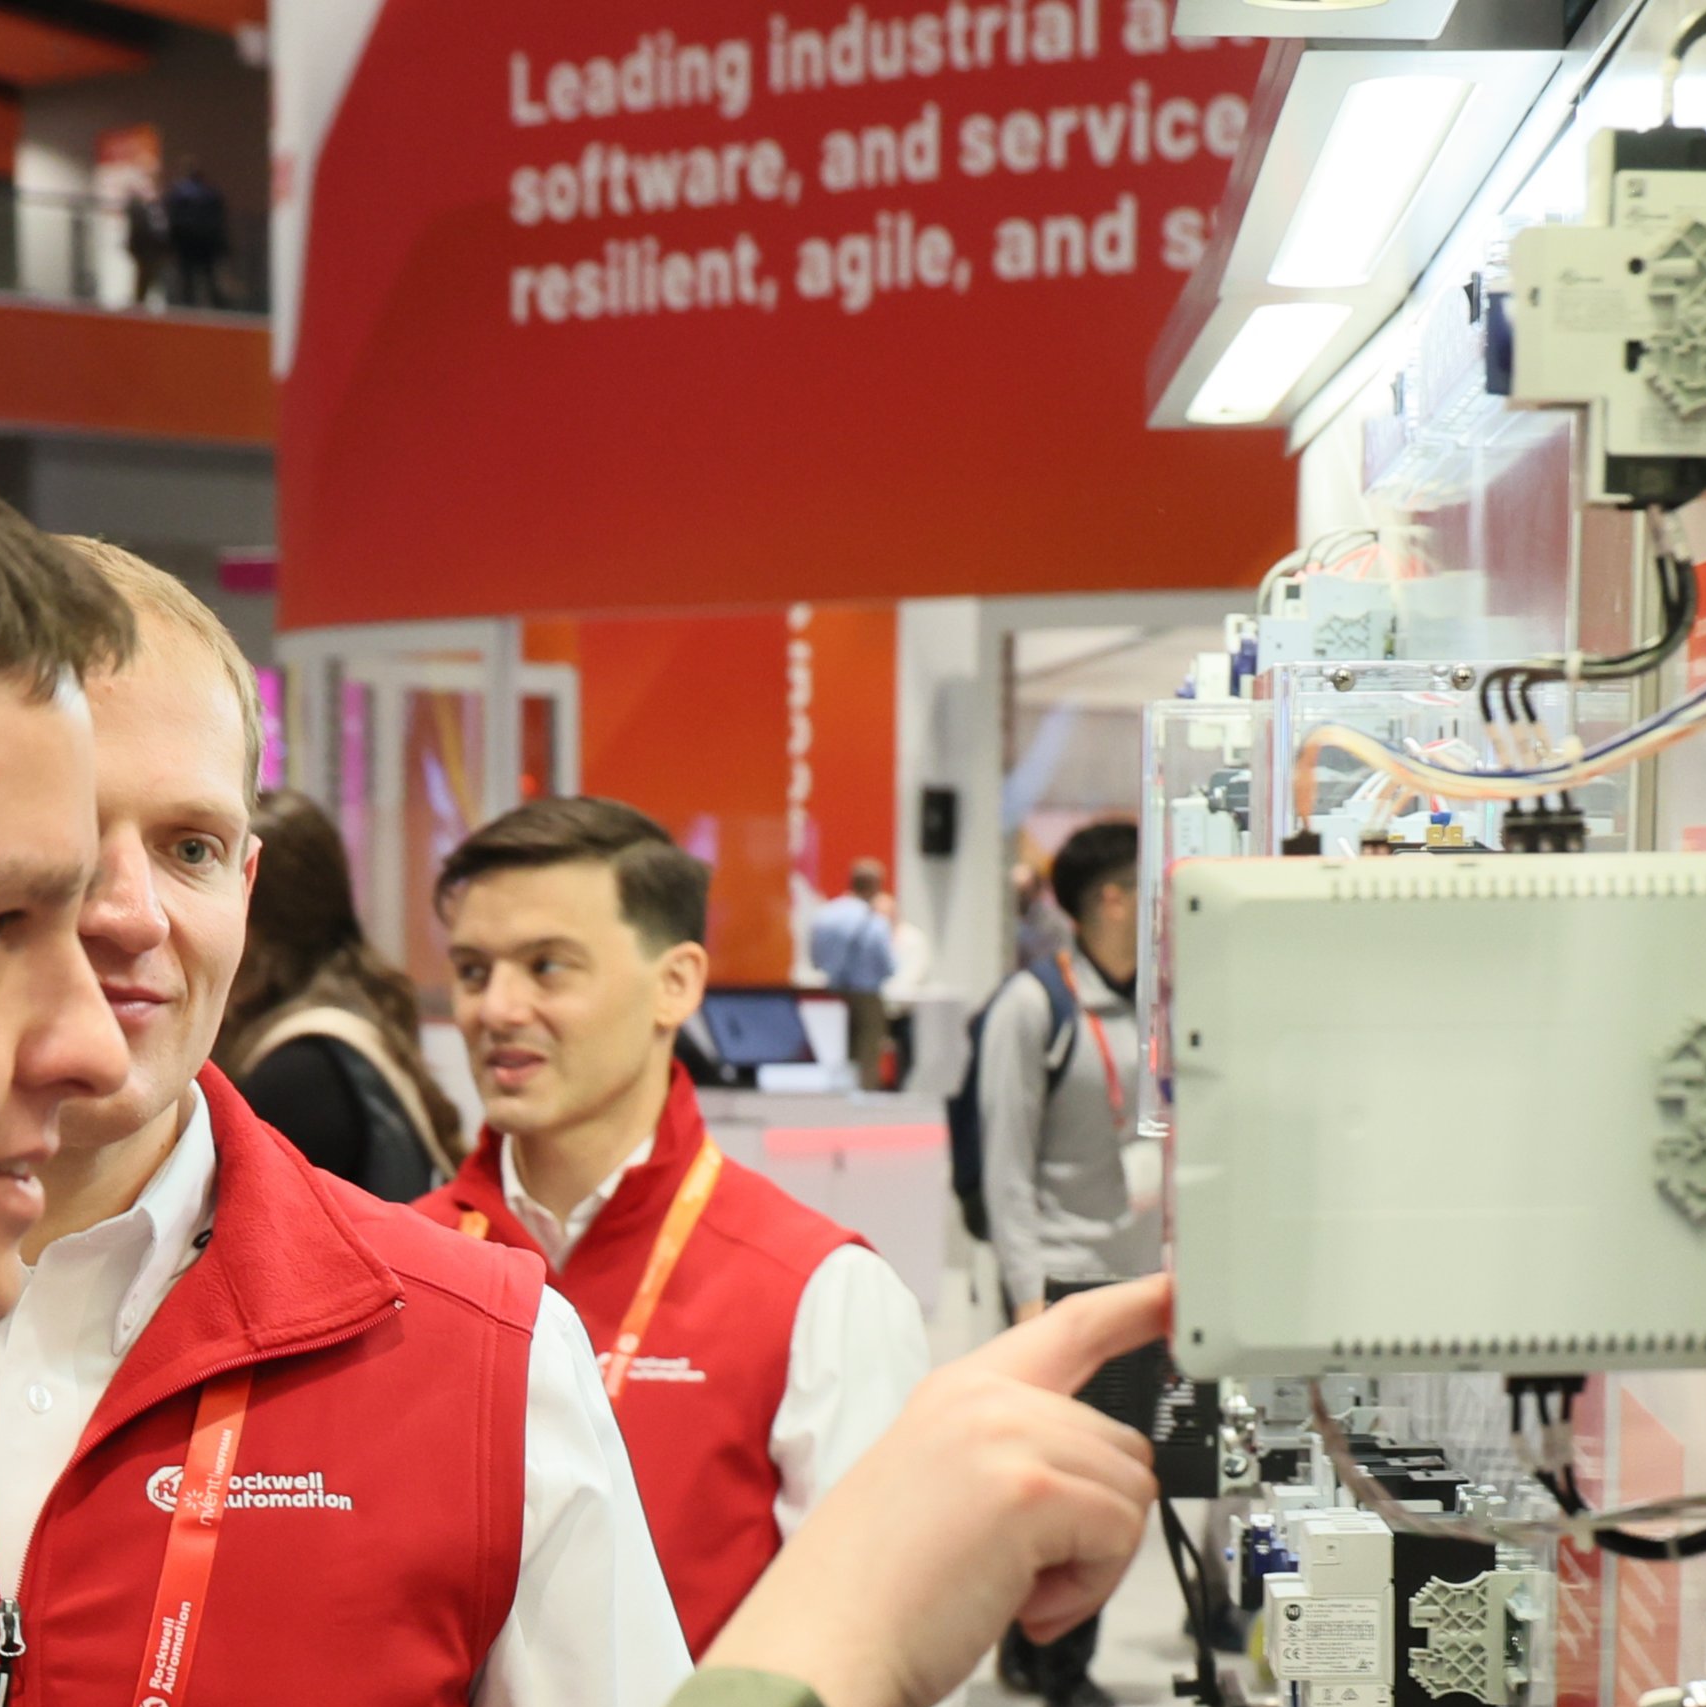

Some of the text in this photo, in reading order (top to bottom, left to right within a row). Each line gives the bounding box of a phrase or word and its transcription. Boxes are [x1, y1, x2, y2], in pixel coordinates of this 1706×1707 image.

[509, 29, 752, 127] Leading
[768, 0, 1100, 94] industrial
[509, 140, 803, 228] software,
[820, 100, 941, 193] and
[509, 230, 779, 326] resilient,
[796, 210, 972, 314] agile,
[994, 192, 1138, 283] and
[214, 1429, 233, 1475] HOFFMAN
[228, 1471, 323, 1490] ockwell
[224, 1489, 354, 1511] utomation
[148, 1616, 175, 1690] Rockwell
[162, 1600, 192, 1695] Automation
